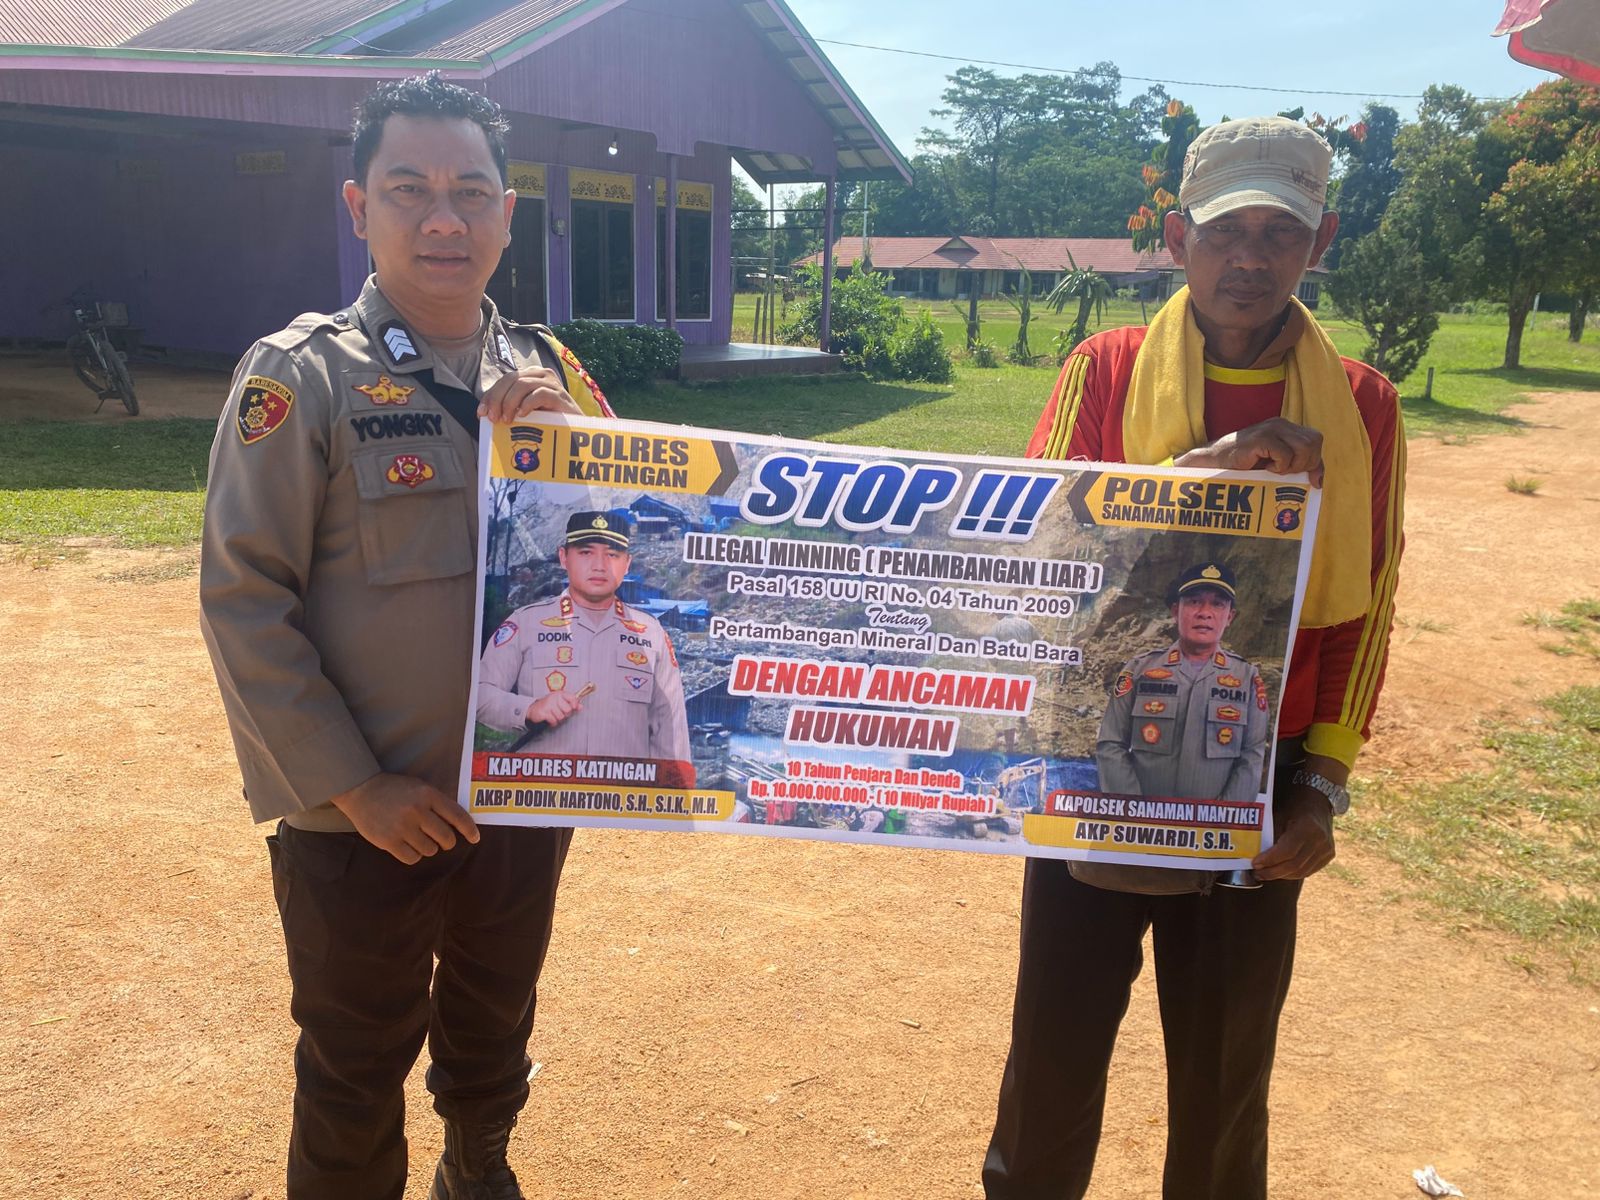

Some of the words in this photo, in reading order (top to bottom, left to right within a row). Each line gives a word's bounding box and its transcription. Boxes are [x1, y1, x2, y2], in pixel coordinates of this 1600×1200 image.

[351, 412, 443, 442] YONGKY
[570, 431, 689, 466] POLRES
[568, 460, 688, 488] KATINGAN
[747, 456, 957, 527] STOP
[956, 473, 1059, 535] !!!
[1102, 476, 1255, 513] POLSEK
[1102, 503, 1176, 525] SANAMAN
[1178, 510, 1251, 530] MANTIKEI
[686, 535, 764, 565] ILLEGAL
[769, 541, 861, 572] MINNING
[878, 550, 1037, 586] PENAMBANGAN
[1040, 562, 1088, 589] LIAR
[730, 574, 783, 593] Pasal
[789, 579, 824, 596] 158
[830, 582, 859, 598] UU
[864, 584, 885, 601] RI
[891, 586, 922, 604] No.
[930, 589, 952, 606] 04
[959, 591, 1018, 611] Tahun
[1024, 597, 1071, 615] 2009
[868, 607, 929, 633] Tentang
[537, 632, 573, 643] DODIK
[619, 634, 652, 648] POLRI
[713, 620, 854, 647] Pertambangan
[861, 629, 932, 652] Mineral
[939, 637, 976, 654] Dan
[983, 639, 1028, 658] Batu
[1034, 643, 1079, 661] Bara
[732, 659, 865, 698] DENGAN
[866, 669, 1031, 711] ANCAMAN
[1211, 687, 1247, 702] POLRI
[789, 709, 955, 752] HUKUMAN
[488, 757, 573, 778] KAPOLRES
[576, 759, 657, 782] KATINGAN
[787, 761, 802, 777] 10
[804, 762, 842, 779] Tahun
[843, 764, 893, 784] Penjara
[894, 769, 919, 785] Dan
[921, 770, 961, 789] Denda
[475, 788, 512, 807] AKBP
[514, 790, 557, 808] DODIK
[559, 791, 624, 812] HARTONO,
[626, 794, 653, 814] S.H.,
[655, 795, 690, 815] S.I.K.,
[691, 797, 719, 815] M.H.
[751, 780, 770, 798] Rp.
[884, 790, 898, 806] 10
[900, 791, 940, 809] Milyar
[942, 794, 986, 813] Rupiah
[1055, 794, 1125, 817] KAPOLSEK
[1127, 801, 1194, 821] SANAMAN
[1197, 804, 1260, 825] MANTIKEI
[1075, 821, 1111, 841] AKP
[1113, 824, 1200, 850] SUWARDI,
[1203, 832, 1234, 850] S.H.
